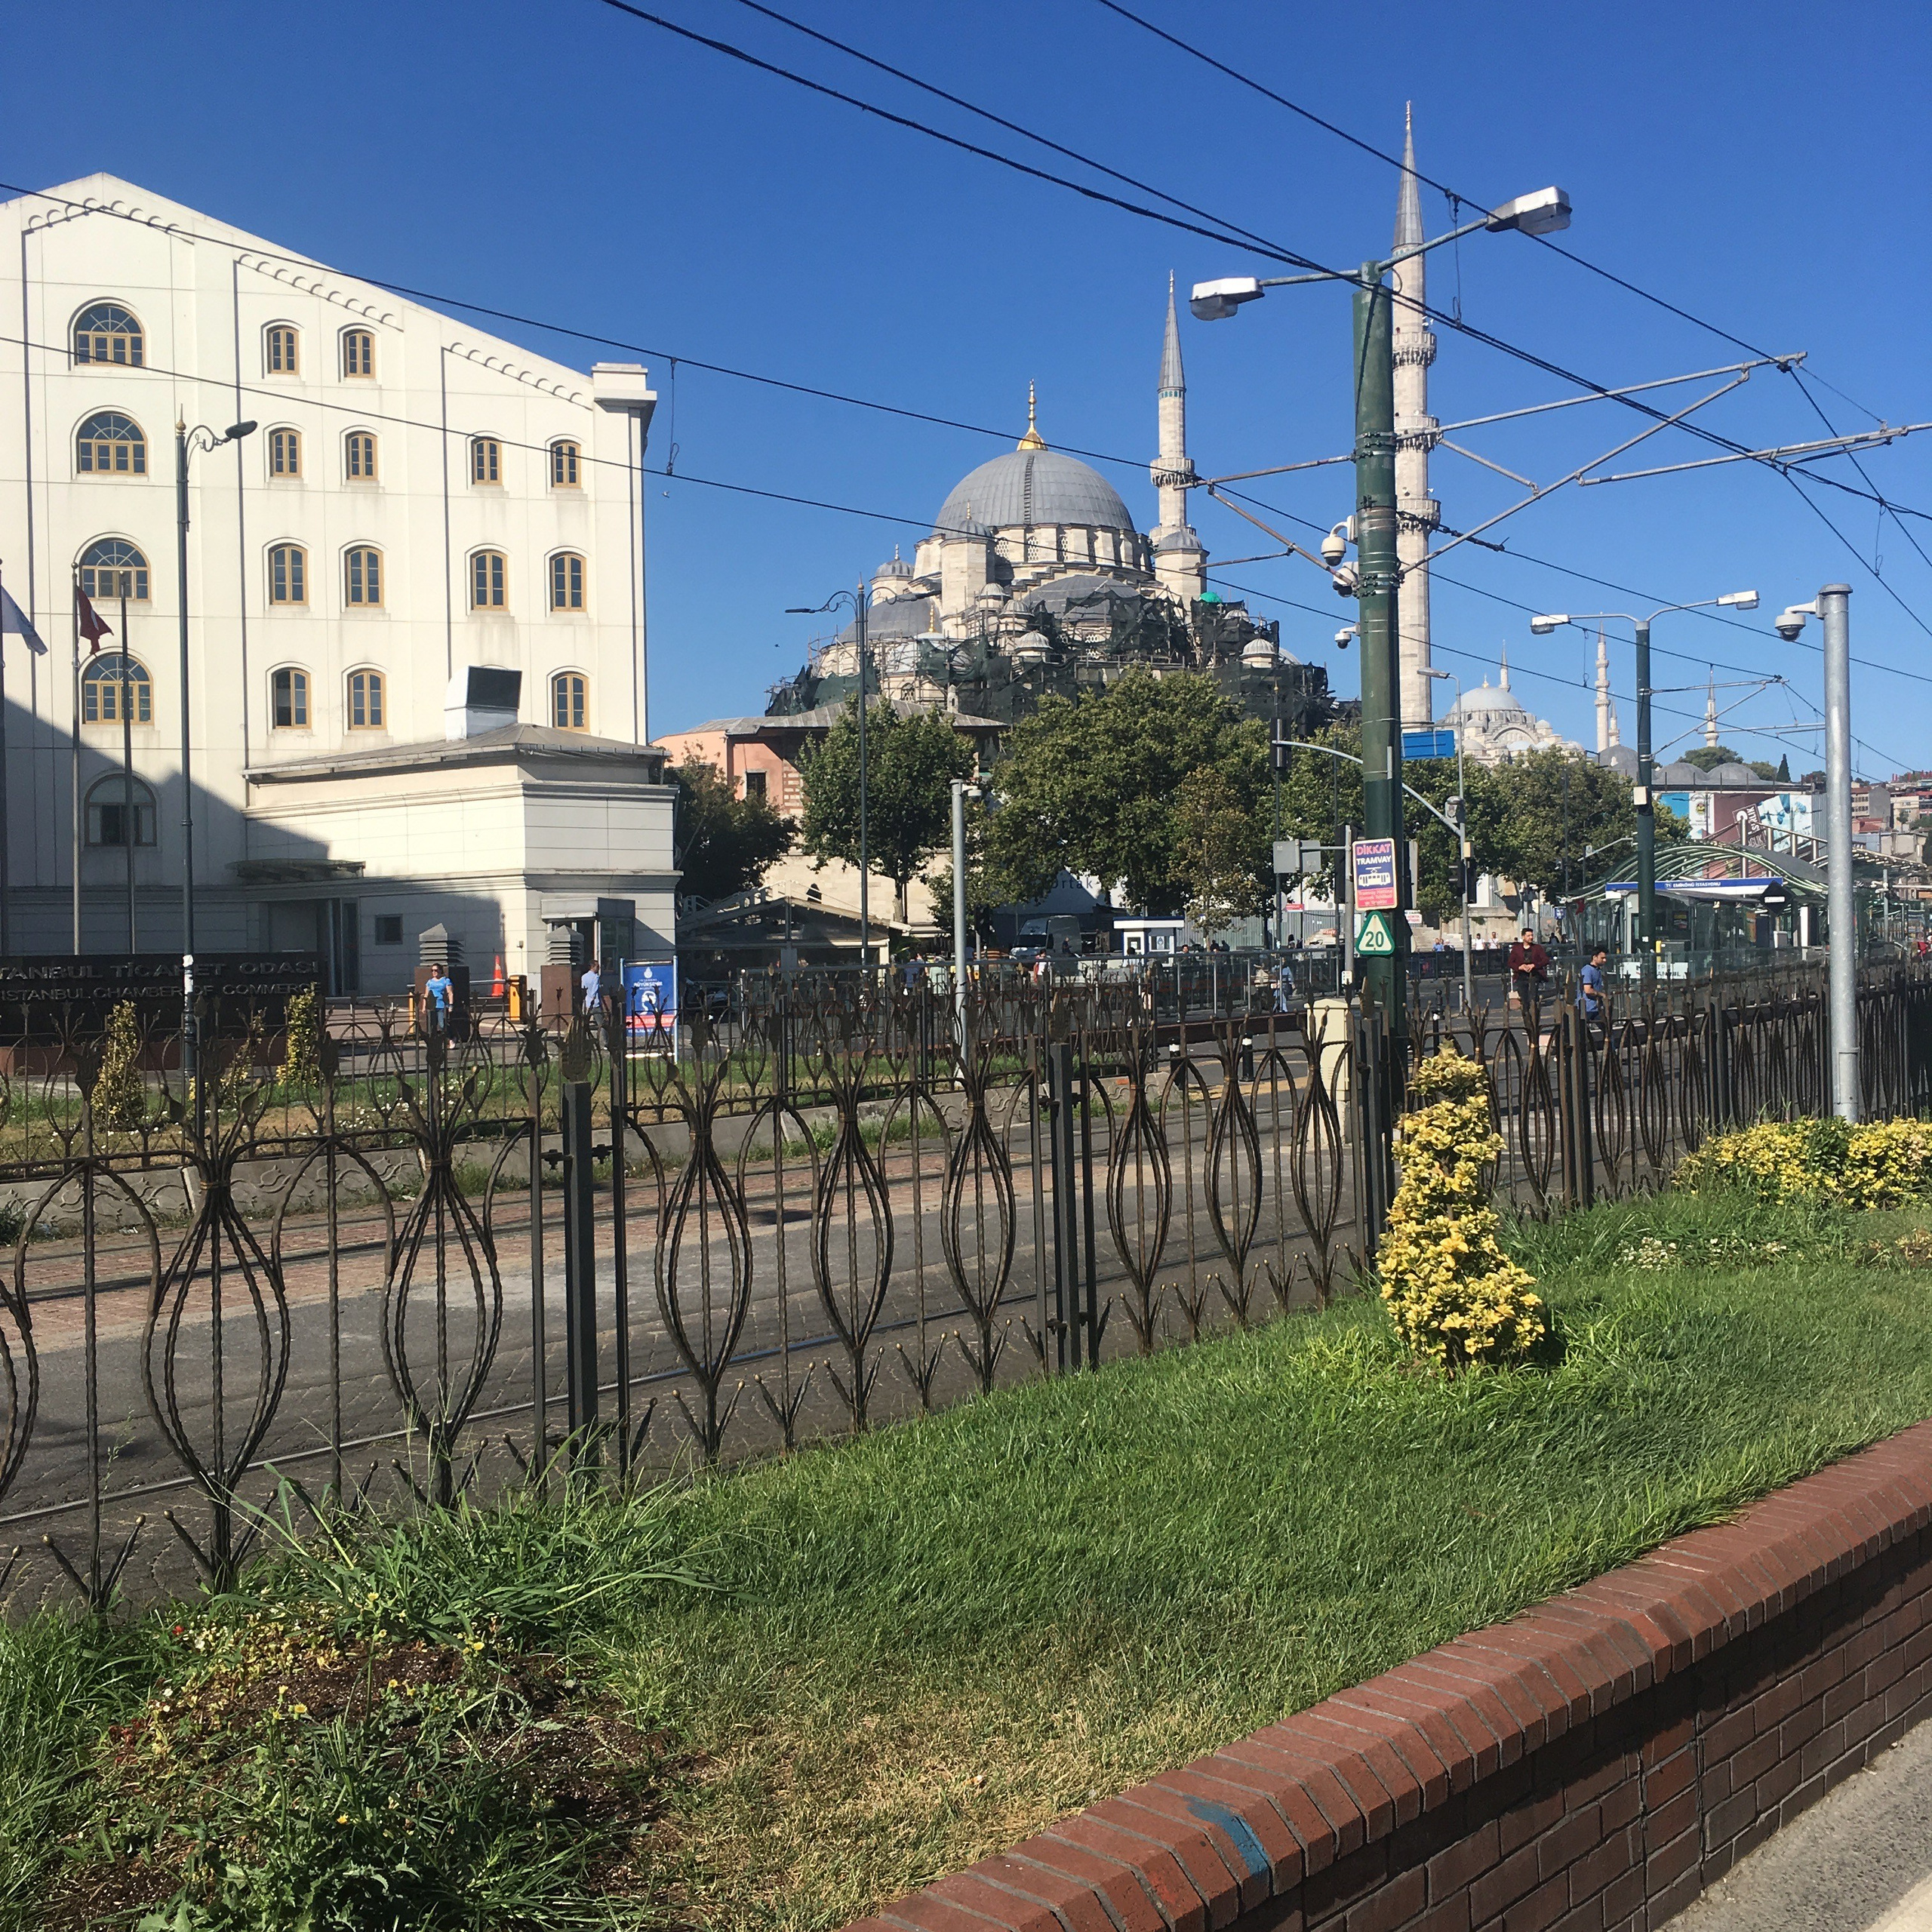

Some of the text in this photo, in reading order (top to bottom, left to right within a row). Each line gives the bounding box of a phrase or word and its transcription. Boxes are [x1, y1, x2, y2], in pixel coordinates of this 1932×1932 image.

[1356, 843, 1391, 856] DİKKAT
[1356, 855, 1392, 866] TRAMVAY
[1365, 931, 1384, 947] 20
[239, 960, 319, 974] ODASI
[1, 987, 91, 1001] ISTANBUL
[93, 986, 183, 998] CHAMBER
[194, 984, 214, 996] OF
